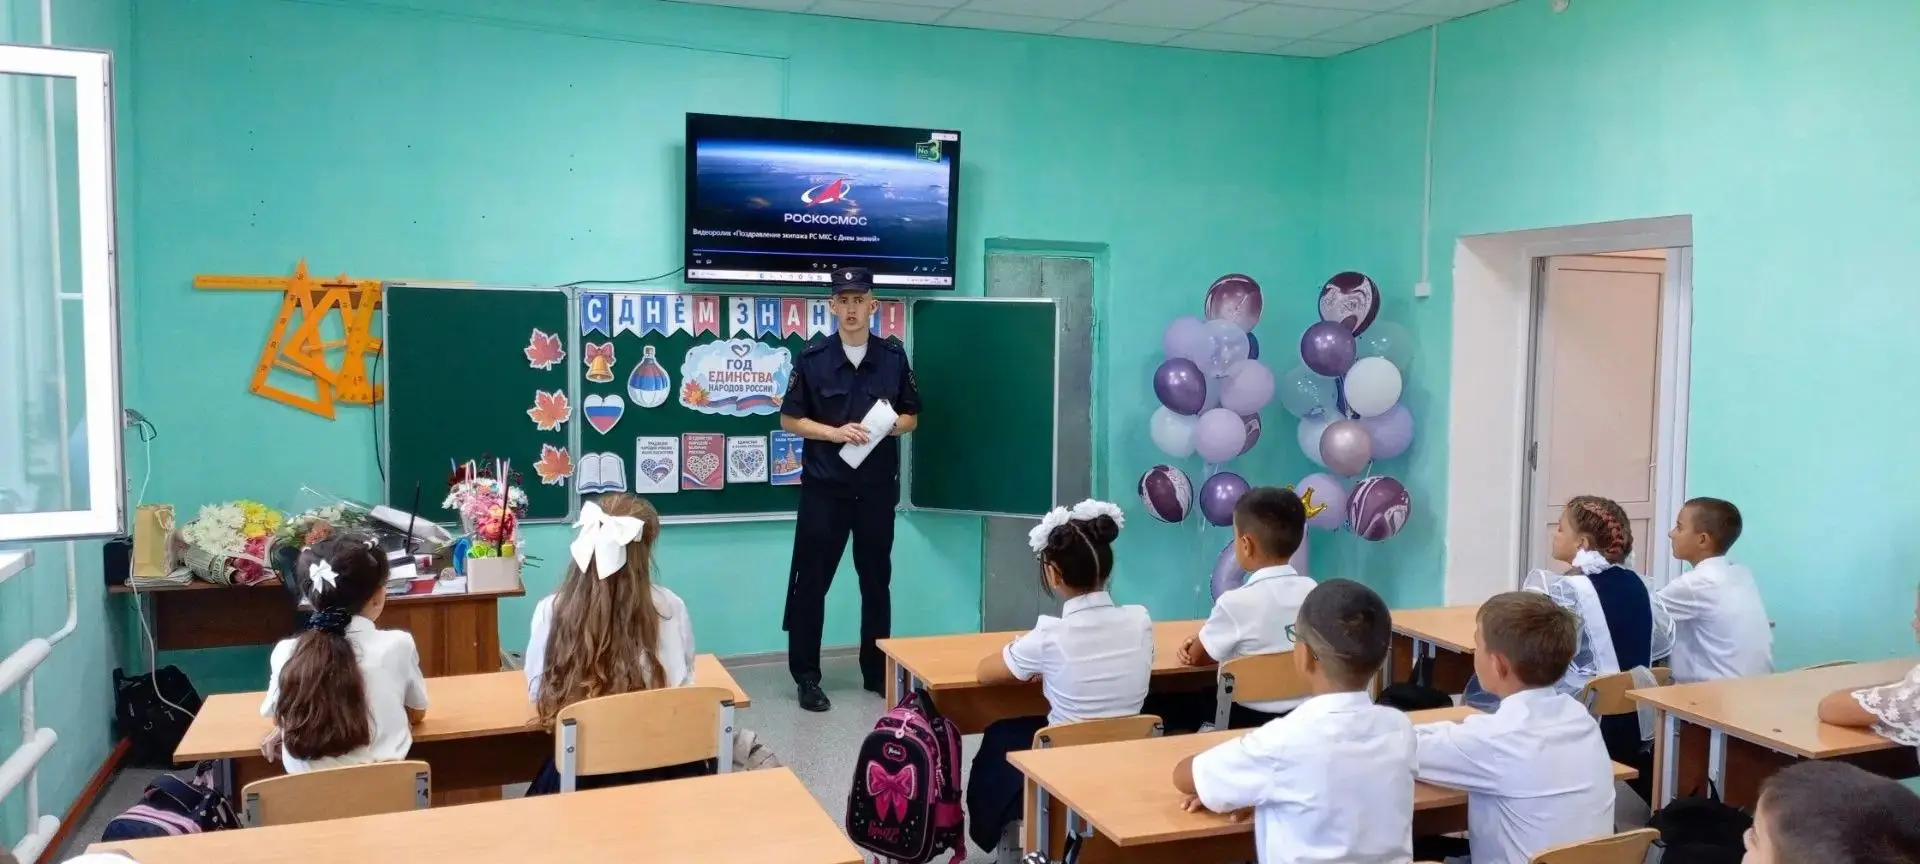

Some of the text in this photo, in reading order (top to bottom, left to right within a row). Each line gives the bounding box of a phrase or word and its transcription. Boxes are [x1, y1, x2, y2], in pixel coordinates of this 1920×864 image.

[784, 213, 868, 226] РОСКОСМОС
[692, 228, 731, 237] Видеоролик
[733, 229, 781, 239] «Поздравление
[782, 232, 808, 240] экипажа
[818, 233, 833, 241] МКС
[587, 296, 896, 330] С ДНЁМ ЗНАН!
[726, 360, 753, 371] ГОД
[708, 371, 773, 384] ЕДИНСТВА
[708, 384, 773, 393] НАРОДОВ РОССИИ
